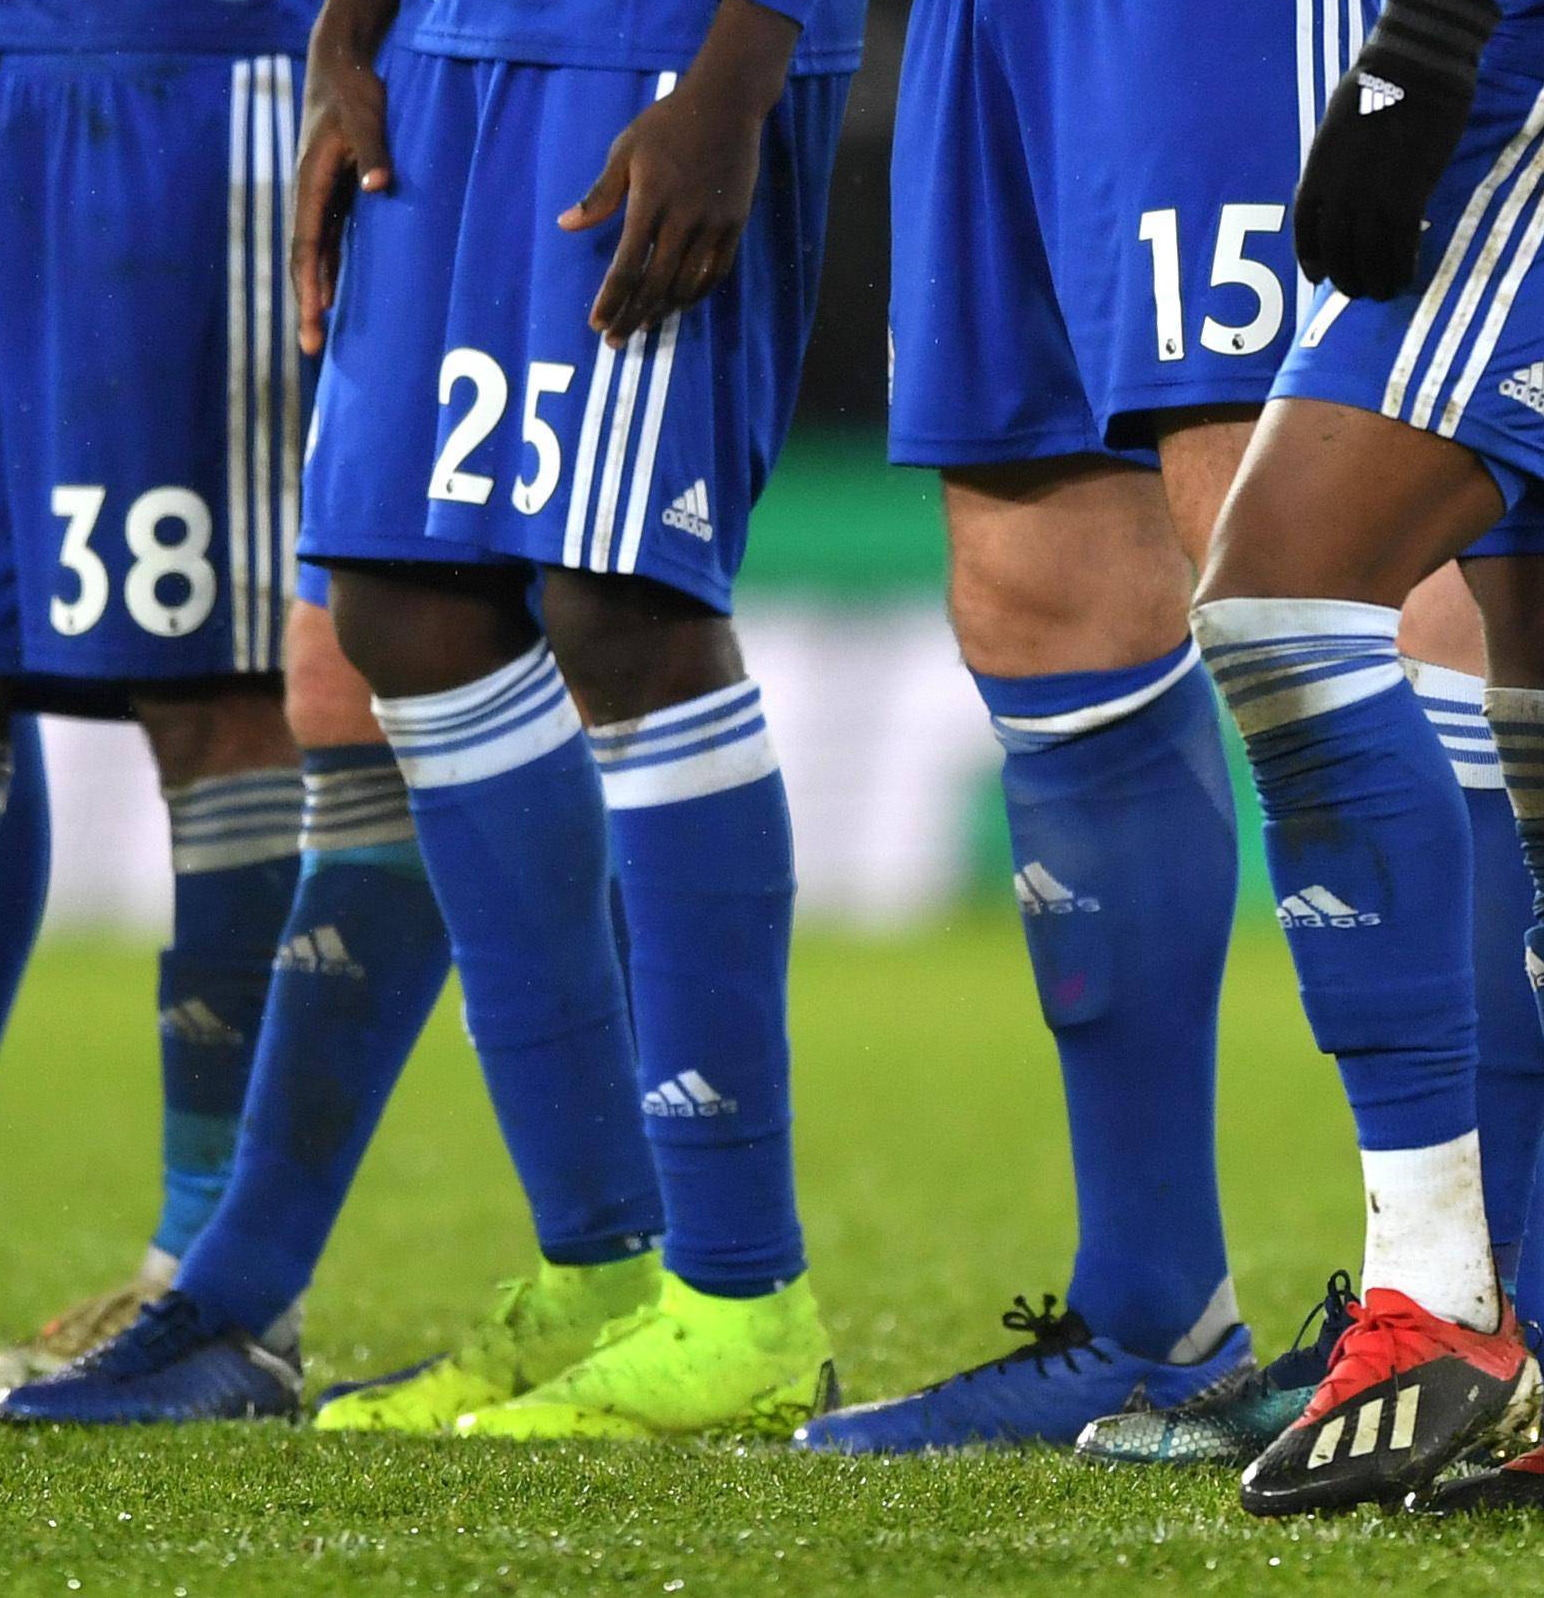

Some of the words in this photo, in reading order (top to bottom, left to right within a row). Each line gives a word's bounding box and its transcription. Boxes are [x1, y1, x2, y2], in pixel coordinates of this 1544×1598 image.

[1138, 203, 1286, 362] 15
[427, 347, 576, 516] 25
[49, 484, 218, 638] 38
[661, 507, 714, 543] adidas
